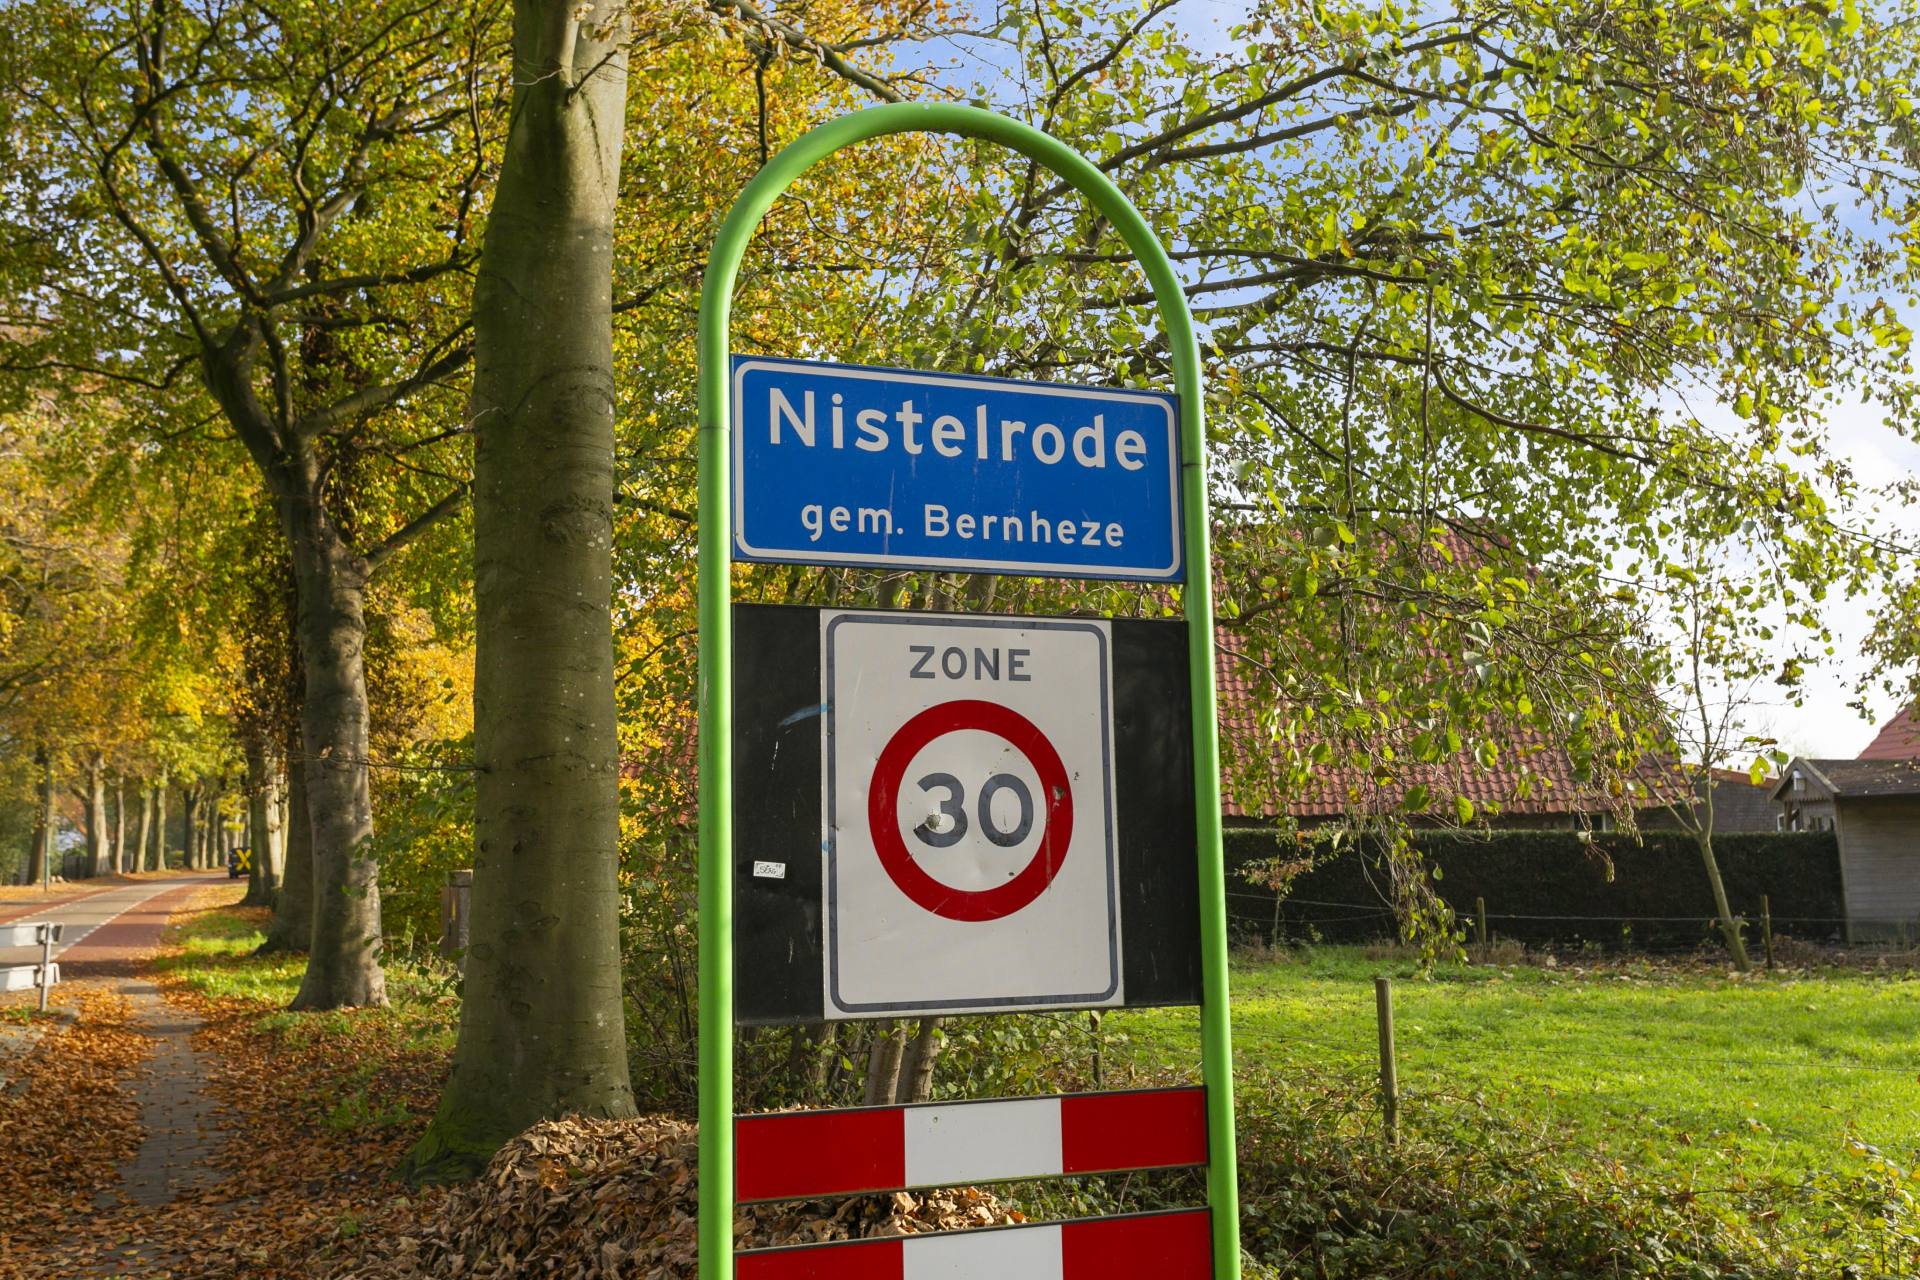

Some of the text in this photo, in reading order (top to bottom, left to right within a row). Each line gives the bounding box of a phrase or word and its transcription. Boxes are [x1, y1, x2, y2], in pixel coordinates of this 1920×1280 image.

[769, 387, 1147, 471] Nistelrode
[801, 504, 1125, 548] gem. Bernheze
[909, 645, 1032, 682] ZONE
[913, 772, 1034, 848] 30
